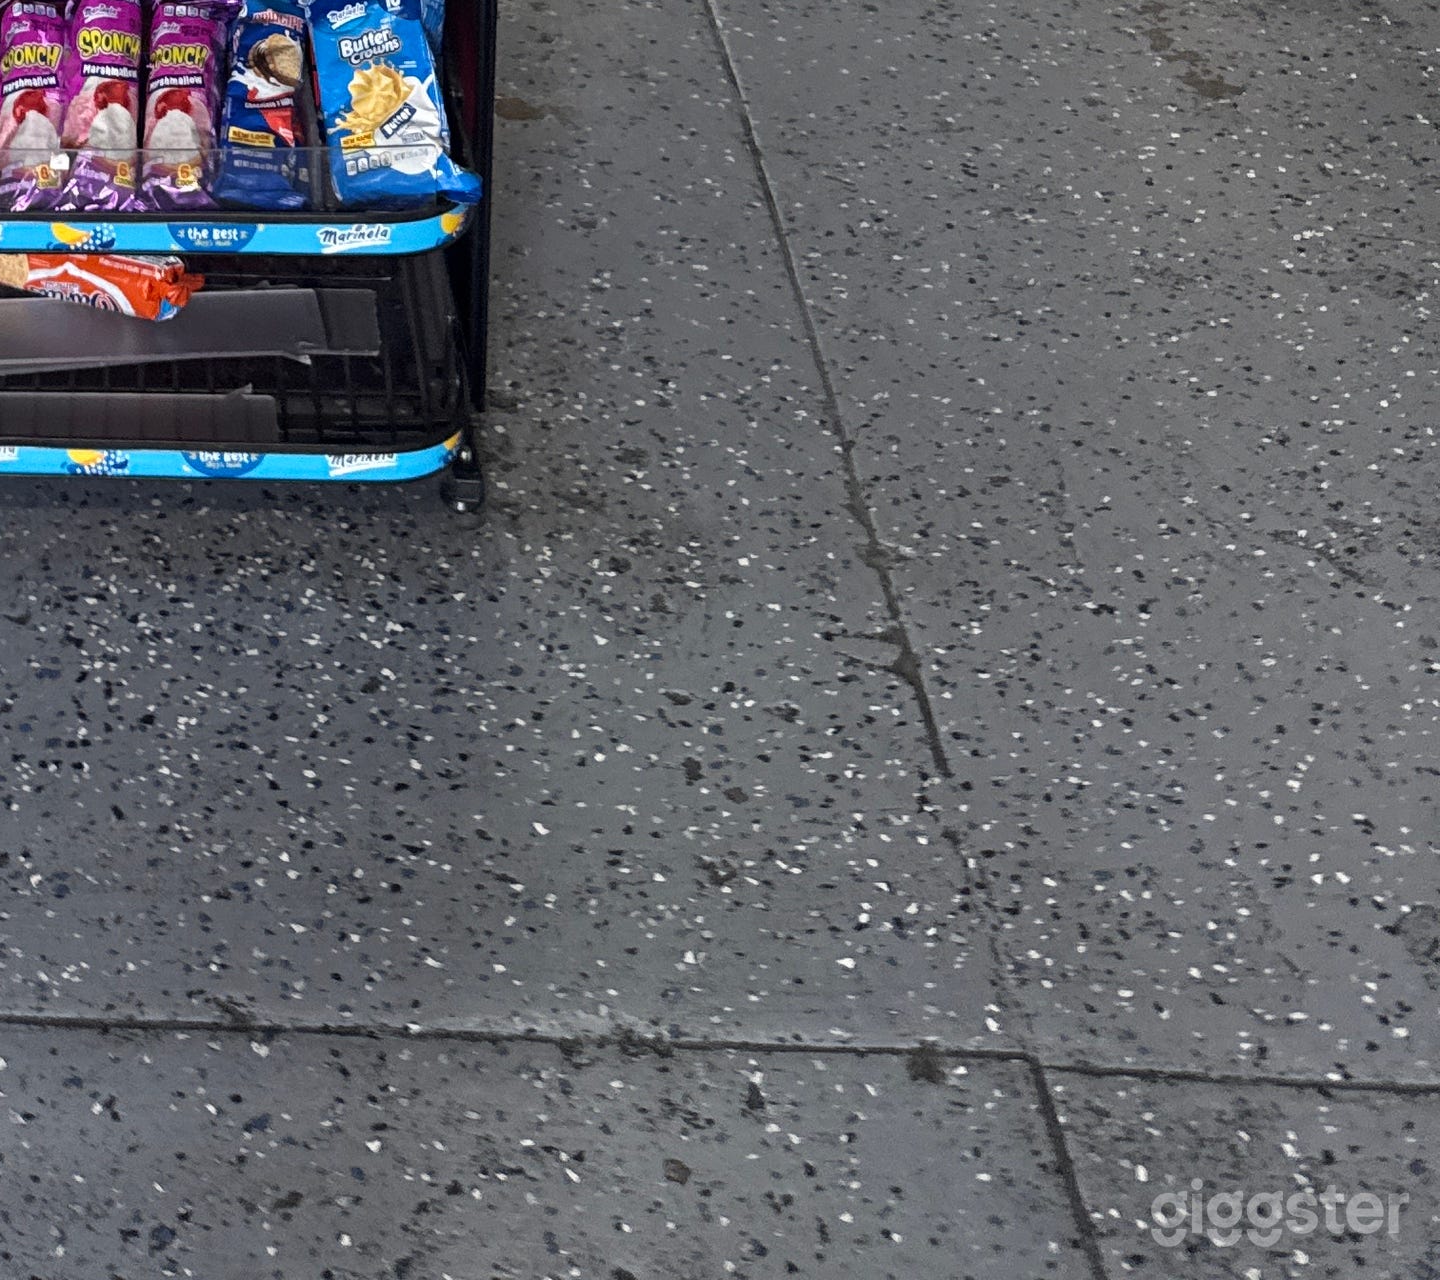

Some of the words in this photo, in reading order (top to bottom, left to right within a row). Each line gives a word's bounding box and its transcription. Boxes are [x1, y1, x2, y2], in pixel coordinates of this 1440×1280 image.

[327, 2, 367, 22] Marinela
[79, 28, 140, 62] SPONCH
[340, 29, 390, 58] Butter
[2, 75, 57, 94] Marshmallow
[384, 107, 414, 136] Butter
[118, 162, 129, 178] 6
[179, 164, 191, 180] 6
[187, 228, 209, 240] the
[212, 228, 238, 241] Best
[321, 223, 390, 244] Marinela
